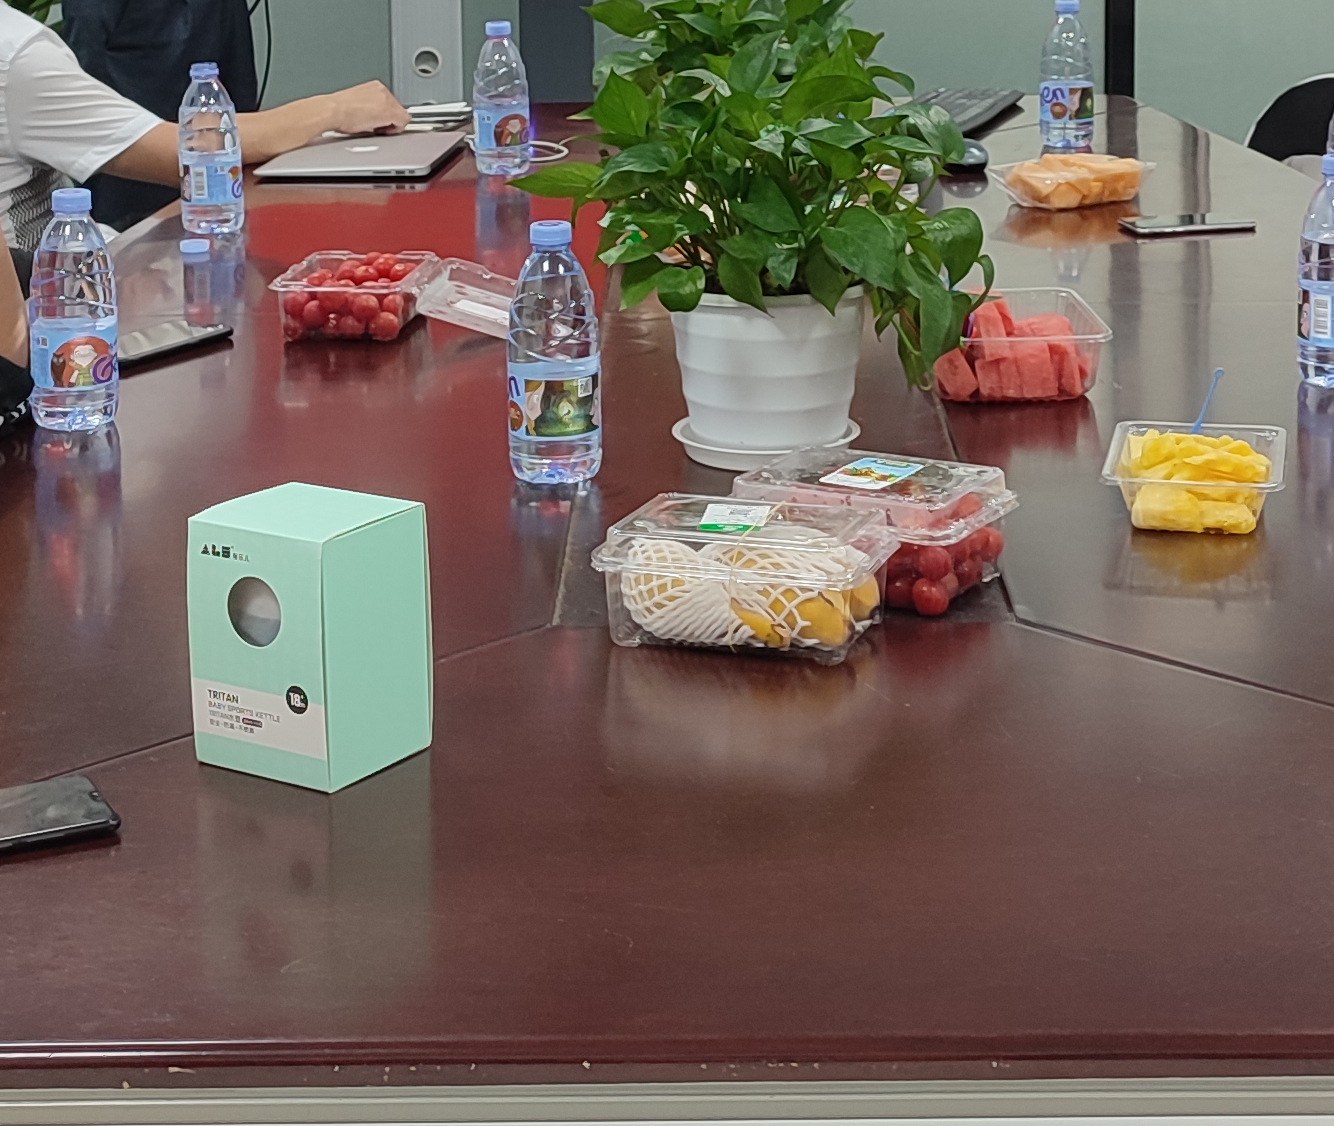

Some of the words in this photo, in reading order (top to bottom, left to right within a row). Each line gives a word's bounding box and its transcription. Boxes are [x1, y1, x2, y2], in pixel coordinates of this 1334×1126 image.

[207, 689, 240, 704] TRITAN
[208, 700, 226, 710] BABY
[227, 704, 254, 717] SPORTS
[255, 711, 281, 723] KETTLE
